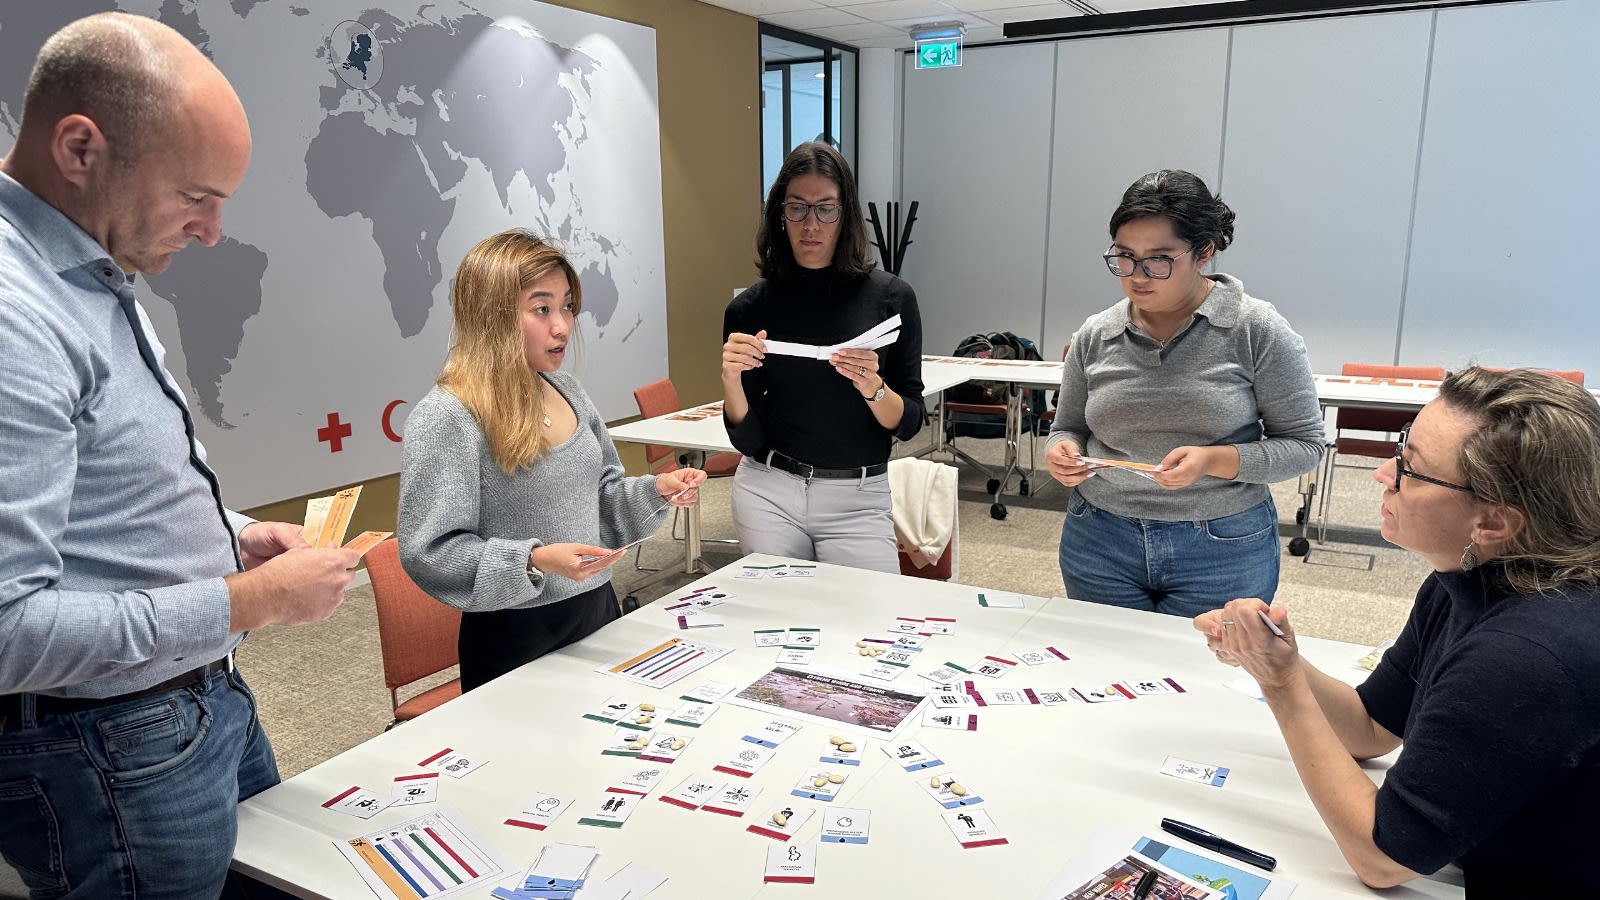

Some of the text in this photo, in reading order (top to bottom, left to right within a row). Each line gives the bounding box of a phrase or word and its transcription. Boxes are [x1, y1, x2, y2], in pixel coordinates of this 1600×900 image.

[806, 674, 831, 682] EXTREME
[831, 679, 850, 687] WINDS
[861, 686, 886, 694] STORMS
